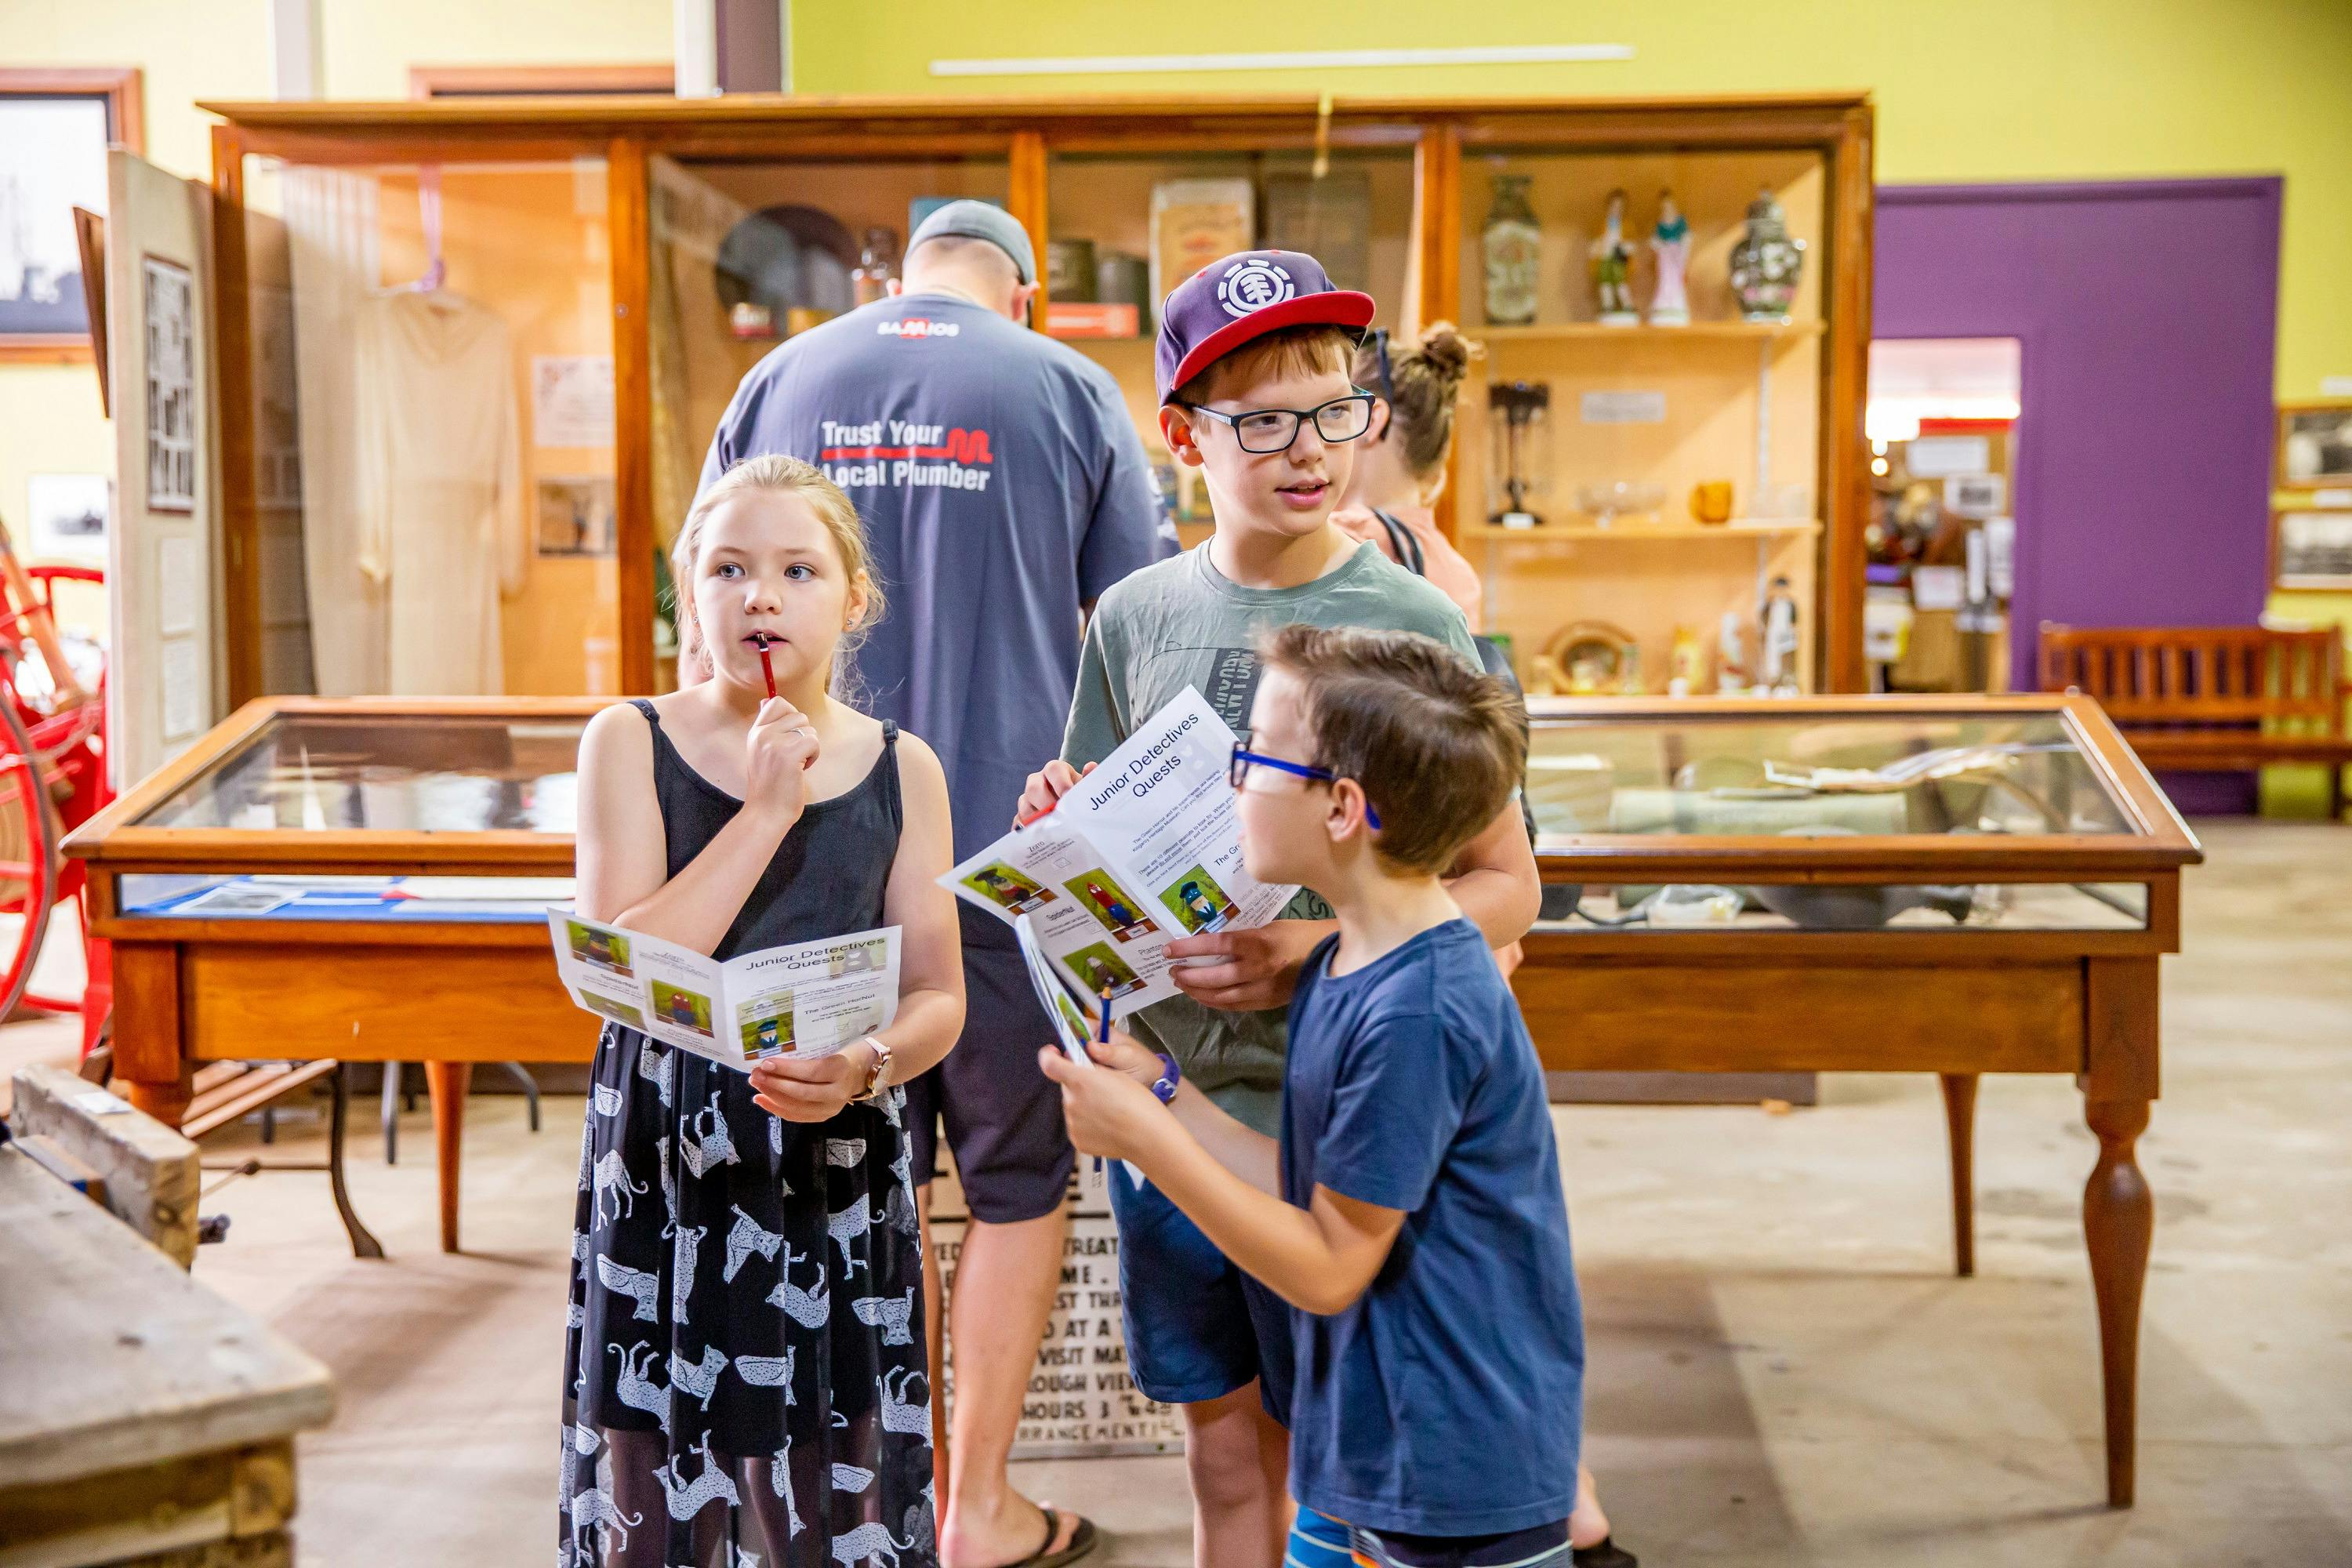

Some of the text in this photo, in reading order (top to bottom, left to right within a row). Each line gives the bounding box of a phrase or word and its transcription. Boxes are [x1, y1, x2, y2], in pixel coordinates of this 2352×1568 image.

[822, 419, 943, 446] Trust Your
[822, 459, 991, 492] Local Plumber
[1090, 712, 1199, 811] Junior Detectives
[1133, 755, 1181, 797] Quests
[1138, 863, 1151, 876] There
[1214, 854, 1229, 866] The
[746, 937, 885, 971] Junior Detectives
[787, 954, 845, 971] Quests
[804, 1007, 819, 1015] The
[821, 1000, 846, 1011] Green
[1065, 1319, 1088, 1338] AT
